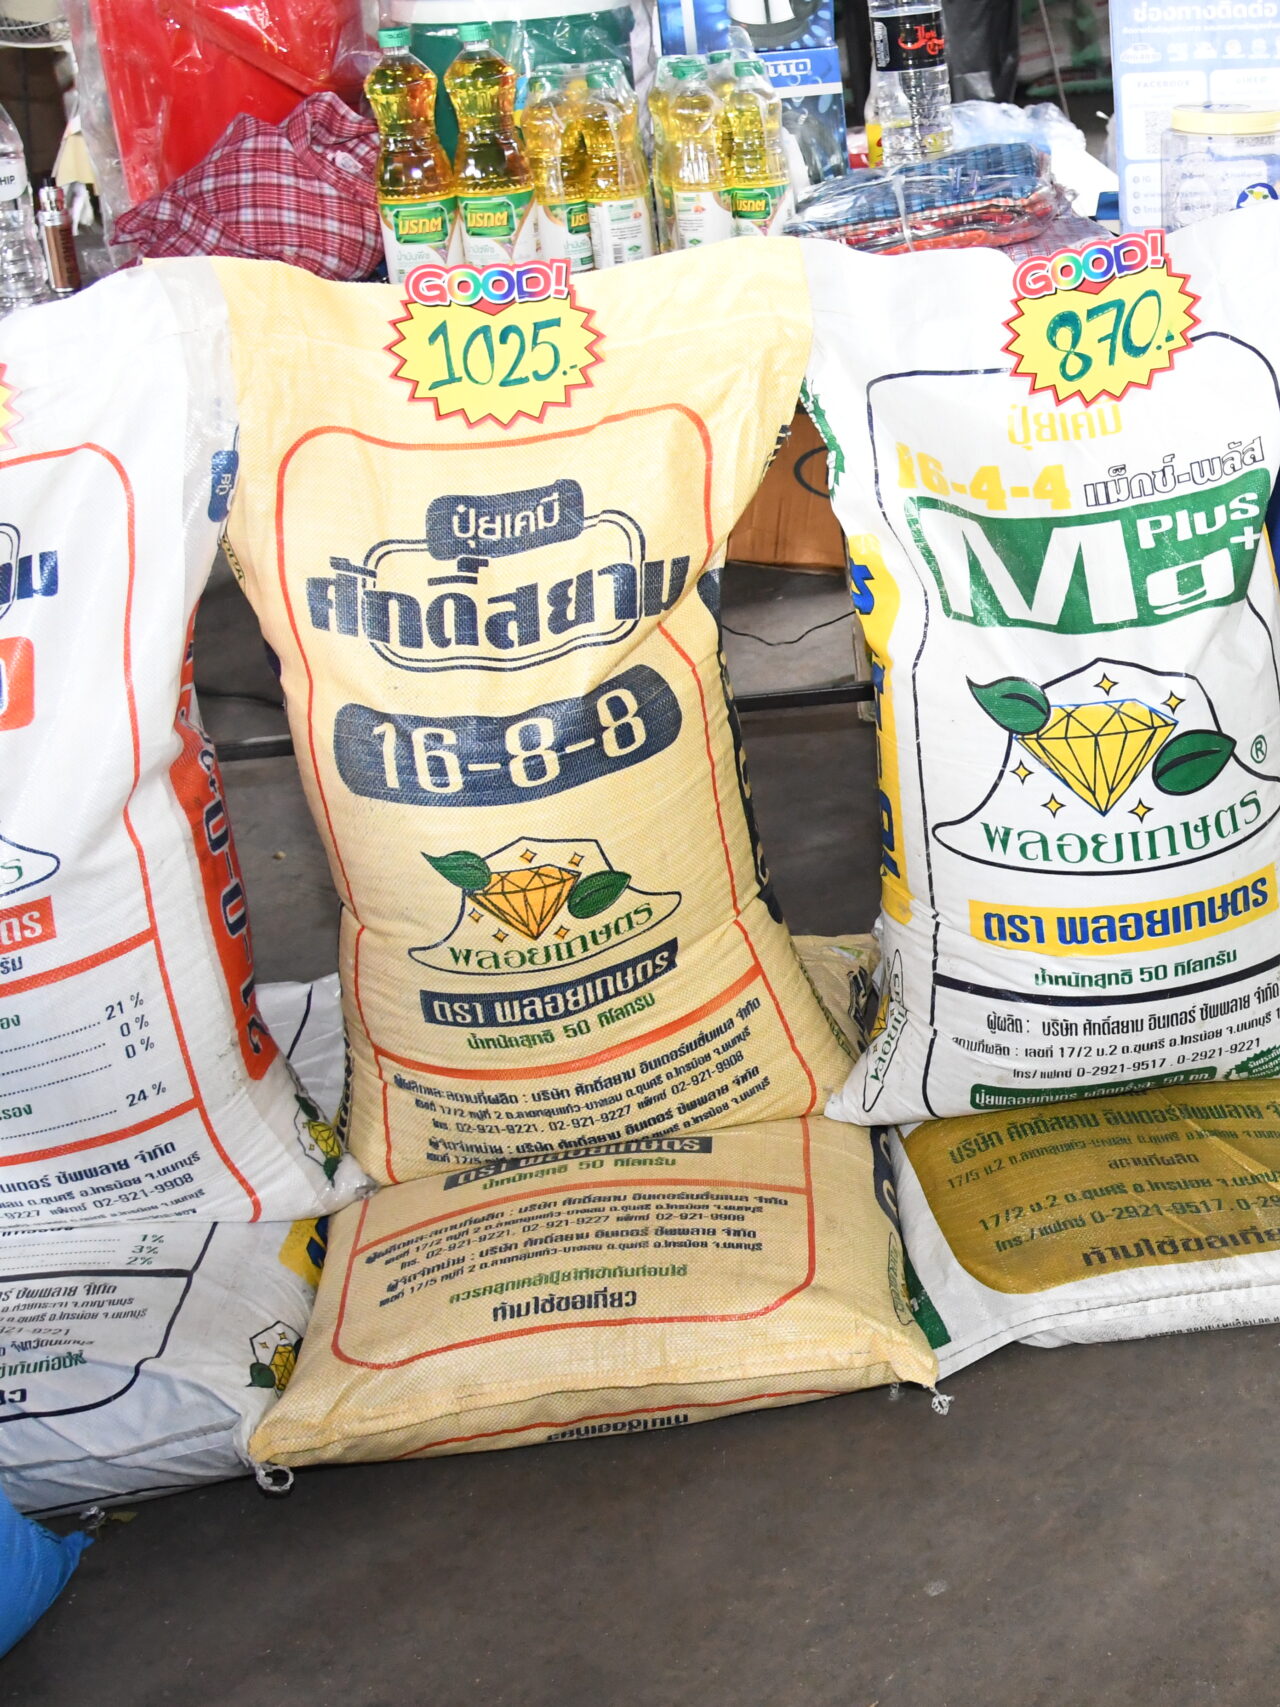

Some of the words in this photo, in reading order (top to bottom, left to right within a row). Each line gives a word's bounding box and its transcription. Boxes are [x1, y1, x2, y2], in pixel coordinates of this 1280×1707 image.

[399, 217, 442, 235] มรกต
[467, 211, 508, 228] มรกต
[571, 212, 588, 227] มร
[406, 259, 570, 305] GOOD!
[1017, 232, 1165, 297] GOOD!
[896, 443, 1071, 510] 16-4-4
[452, 495, 560, 547] ปุ๋ยเคมี
[306, 556, 690, 650] ศักดิ์สยาม
[372, 688, 647, 793] 16-8-8
[981, 790, 1263, 864] พลอยเกษตร
[983, 907, 1044, 944] ตรา
[1058, 876, 1269, 944] พลอยเกษตร
[447, 901, 654, 970] พลอยเกษตร
[1034, 964, 1134, 988] น้ำหนักสุทธิ
[1139, 963, 1168, 981] 50
[1173, 948, 1237, 978] กิโลกรัม
[433, 1001, 483, 1025] ตรา
[494, 950, 670, 1022] พลอยเกษตร
[105, 1001, 124, 1022] 21
[131, 992, 144, 1008] %
[563, 1019, 591, 1039] 50
[597, 992, 656, 1028] กิโลกรัม
[1042, 1019, 1078, 1036] บริษัท
[1083, 1015, 1144, 1036] ศักดิ์สยาม
[1149, 1002, 1196, 1031] อินเตอร์
[1254, 982, 1280, 1004] จำกัด
[120, 1021, 131, 1038] 0
[135, 1014, 149, 1030] %
[125, 1043, 136, 1060] 0
[140, 1036, 155, 1053] %
[1058, 1045, 1092, 1058] 17/2
[1096, 1044, 1118, 1057] ม.2
[1077, 1058, 1166, 1077] 0-2921-9517
[1177, 1037, 1261, 1065] 0-2921-9221
[126, 1086, 148, 1108] 24
[152, 1081, 167, 1096] %
[531, 1087, 571, 1102] บริษัท
[549, 1105, 631, 1132] 02-921-9227
[670, 1050, 744, 1095] 02-921-9908
[134, 1141, 176, 1163] จำกัด
[578, 1159, 604, 1170] 50
[950, 1131, 1004, 1165] บริษัท
[93, 1172, 194, 1208] 02-921-9908
[522, 1215, 609, 1234] 02-921-9227
[655, 1213, 745, 1222] 02-921-9908
[979, 1206, 1024, 1232] 17/2
[493, 1287, 637, 1321] ห้ามใช้ขอเกี่ยว
